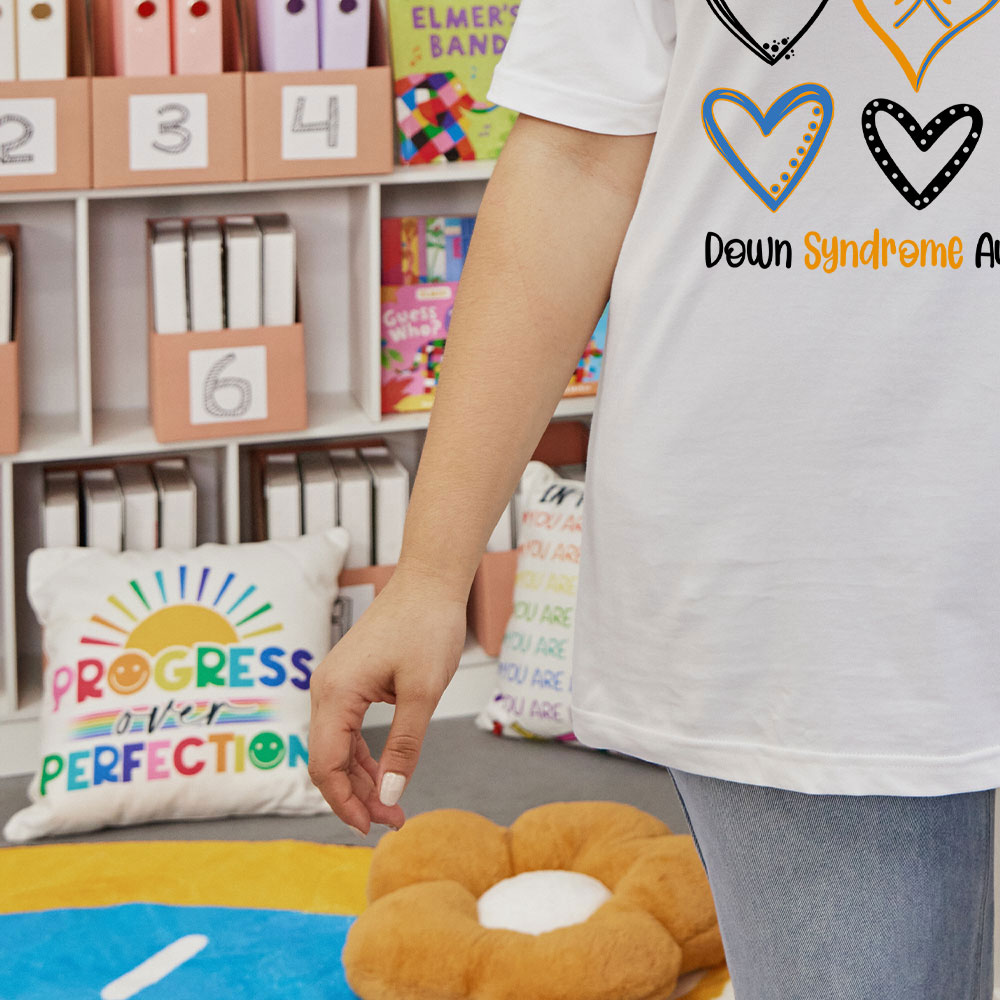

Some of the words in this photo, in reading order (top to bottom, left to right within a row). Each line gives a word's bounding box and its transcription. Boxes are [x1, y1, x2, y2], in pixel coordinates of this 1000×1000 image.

[430, 34, 508, 59] BAND
[152, 103, 193, 154] 3
[291, 96, 339, 148] 4
[0, 115, 35, 162] 2
[704, 232, 793, 269] Down
[803, 228, 964, 275] Syndrome
[382, 305, 438, 328] Guess
[387, 318, 443, 343] Who?
[204, 352, 253, 417] 6
[514, 601, 540, 623] OU
[540, 604, 574, 630] ARE
[535, 635, 568, 660] ARE
[531, 667, 565, 692] ARE
[115, 699, 243, 735] over
[529, 699, 563, 721] ARE
